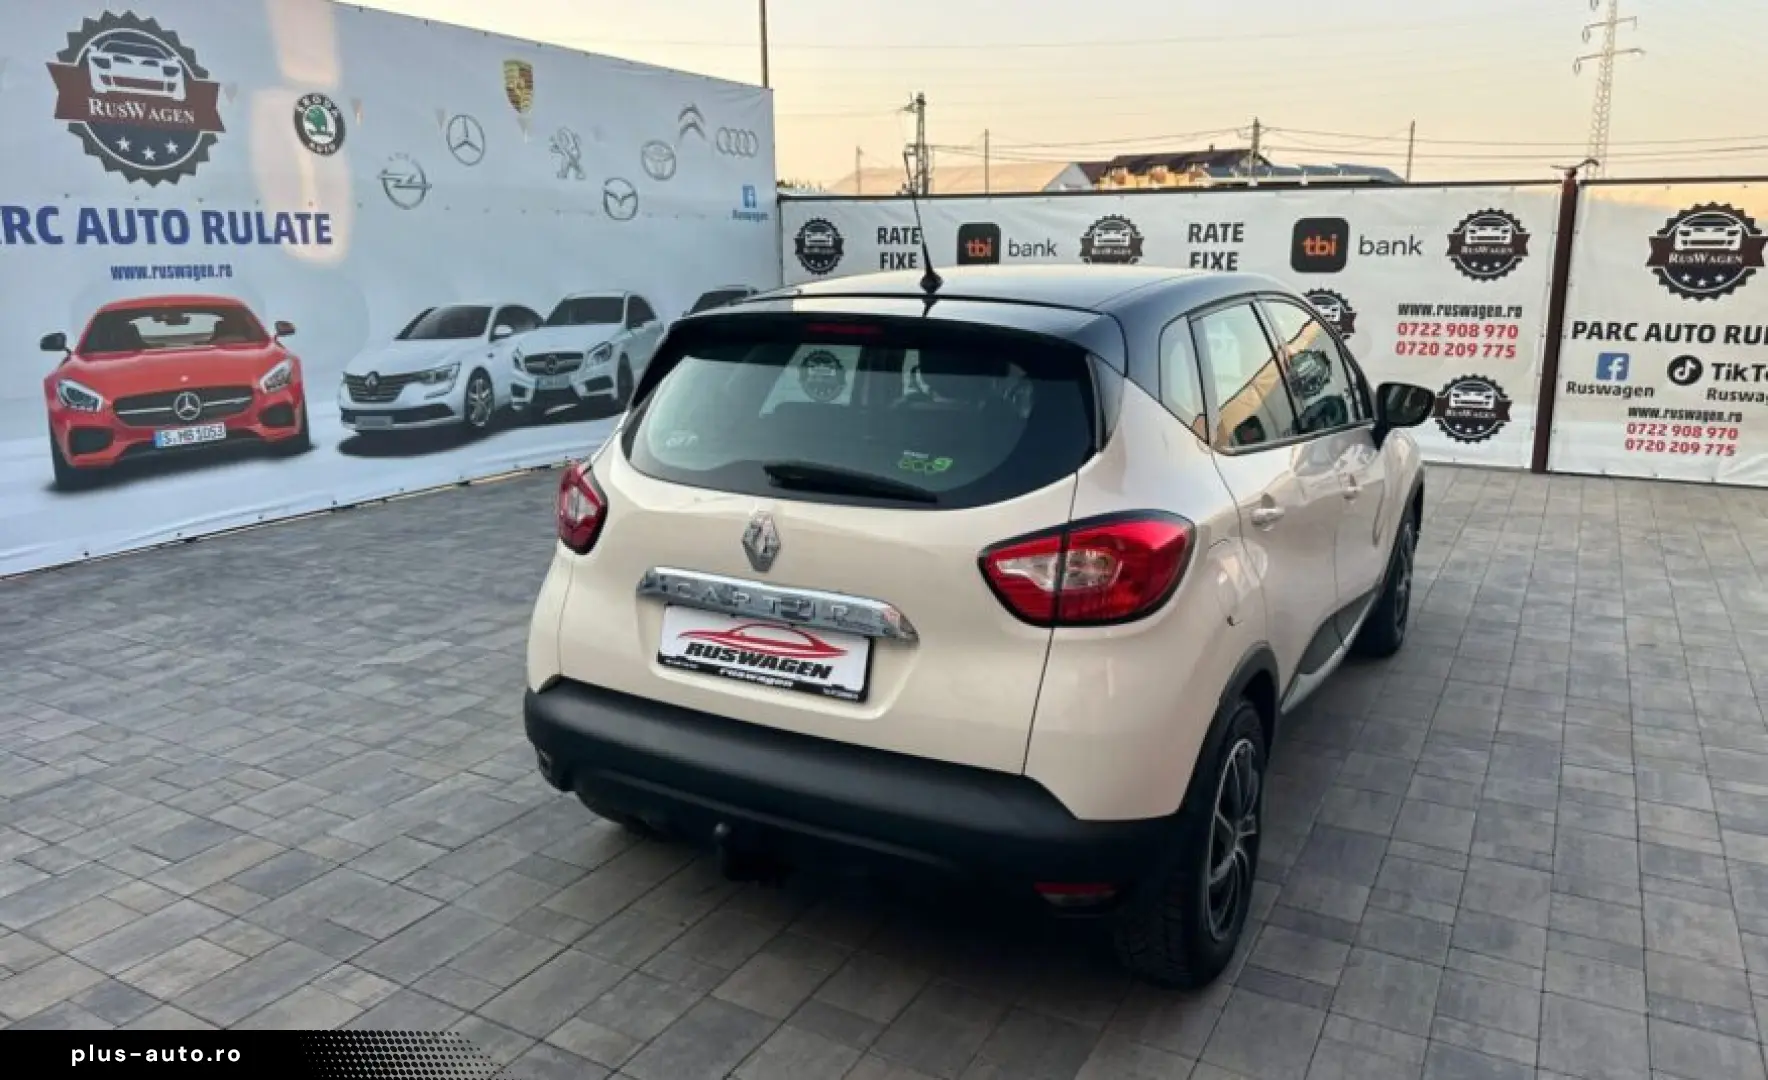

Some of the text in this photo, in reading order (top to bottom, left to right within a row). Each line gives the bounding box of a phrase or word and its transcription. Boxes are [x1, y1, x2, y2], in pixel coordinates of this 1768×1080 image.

[0, 206, 333, 245] RC AUTO RULATE
[1188, 223, 1245, 243] RATE
[877, 226, 922, 245] RATE
[967, 238, 1058, 257] tbi bank
[1303, 235, 1424, 257] tbi bank
[880, 252, 918, 270] FIXE
[1190, 251, 1239, 271] FIXE
[1398, 304, 1523, 320] www.ruswagen.ro
[1397, 322, 1519, 339] 0722 908 970
[1572, 321, 1639, 341] PARC
[1644, 323, 1717, 343] AUTO
[1395, 341, 1517, 358] 0720 209 775
[1711, 363, 1768, 382] TikT
[1566, 381, 1655, 399] Ruswagen
[1626, 423, 1739, 440] 0722 908 970
[1624, 439, 1736, 457] 0720 209 775
[685, 641, 834, 679] RUSWAGEN
